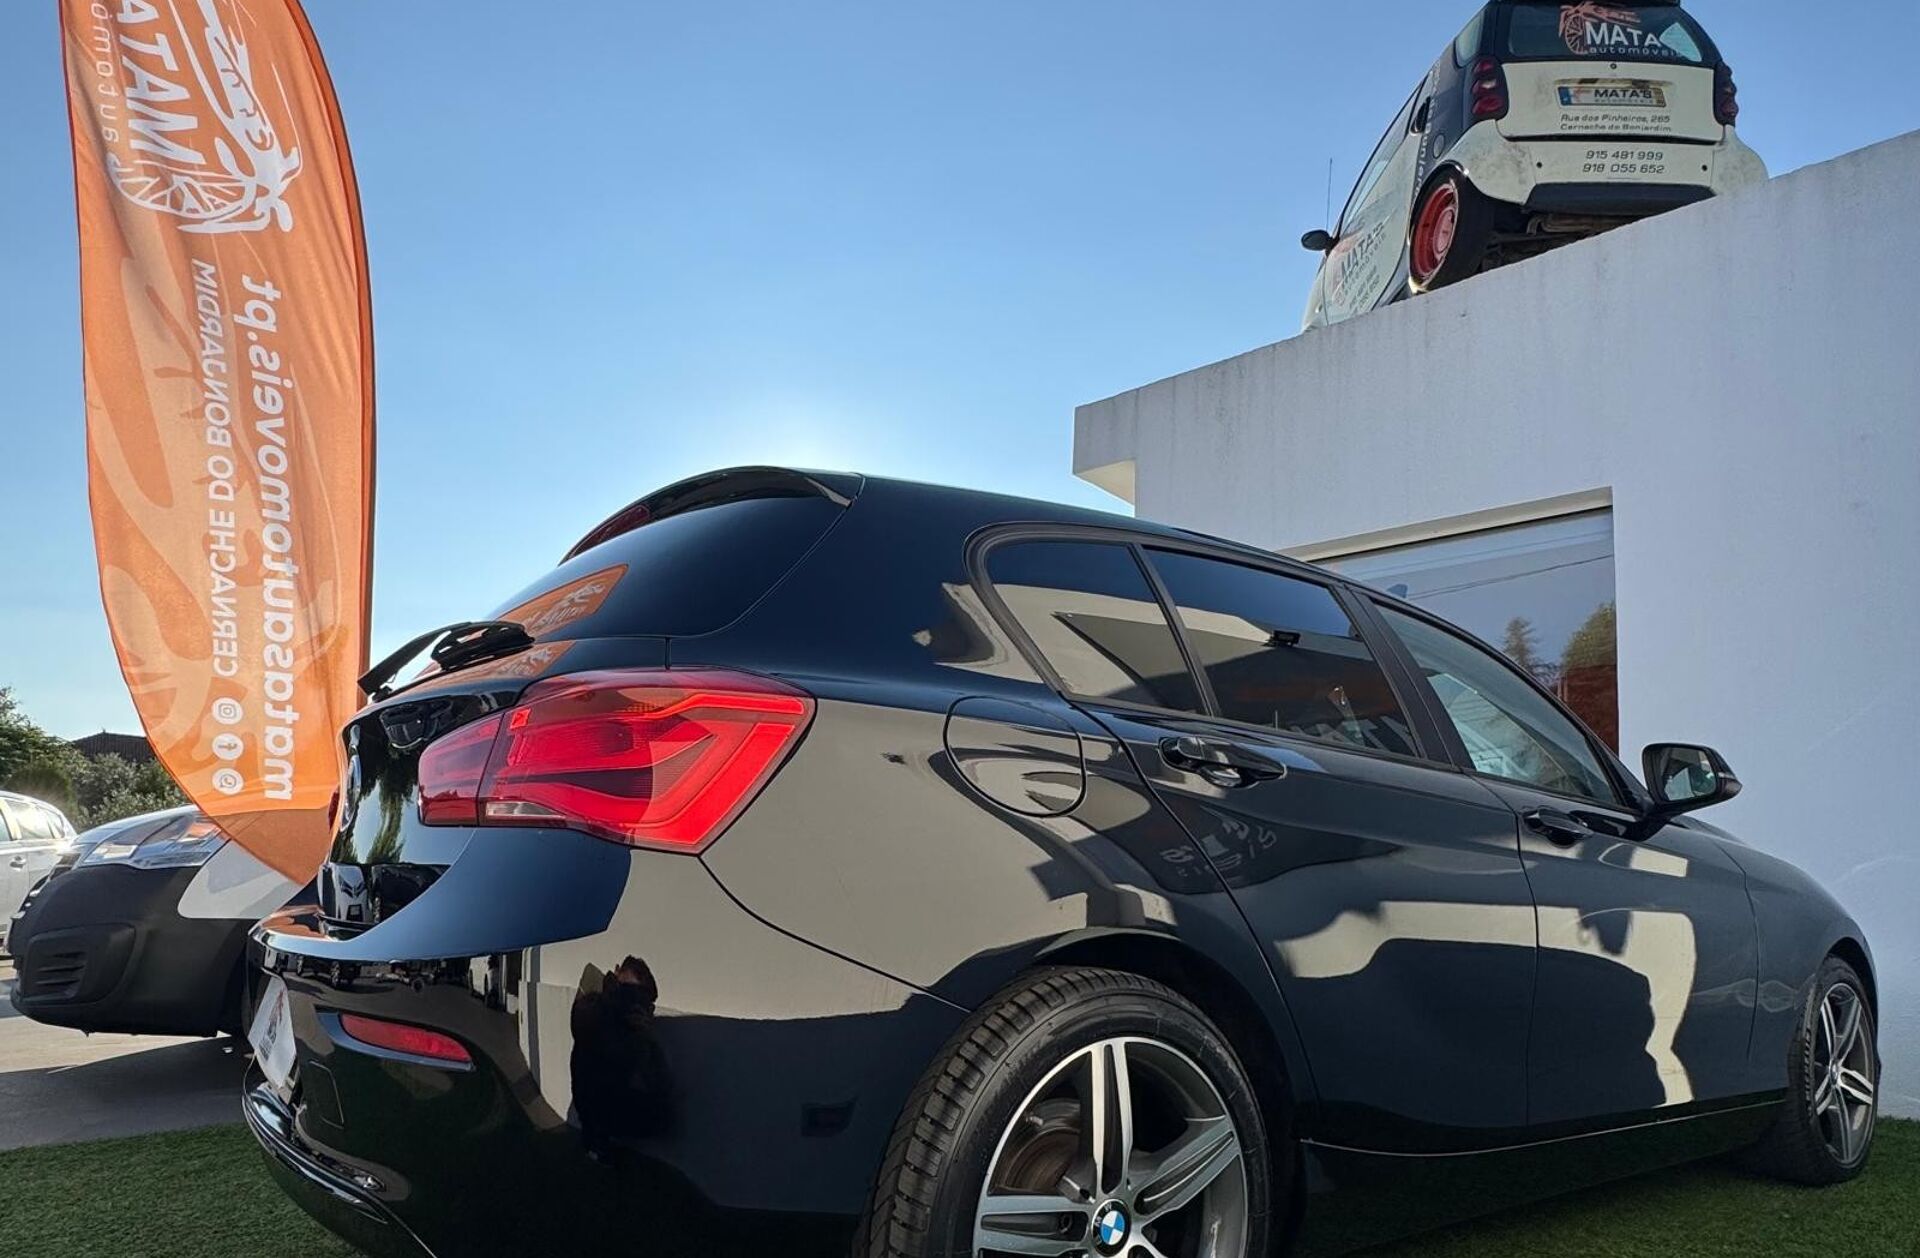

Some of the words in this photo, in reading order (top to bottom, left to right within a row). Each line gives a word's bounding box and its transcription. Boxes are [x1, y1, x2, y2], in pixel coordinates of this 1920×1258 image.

[1586, 150, 1608, 160] 915
[1611, 150, 1634, 160] 481
[1637, 151, 1664, 161] 999
[1582, 163, 1606, 173] 918
[1640, 163, 1665, 174] 652
